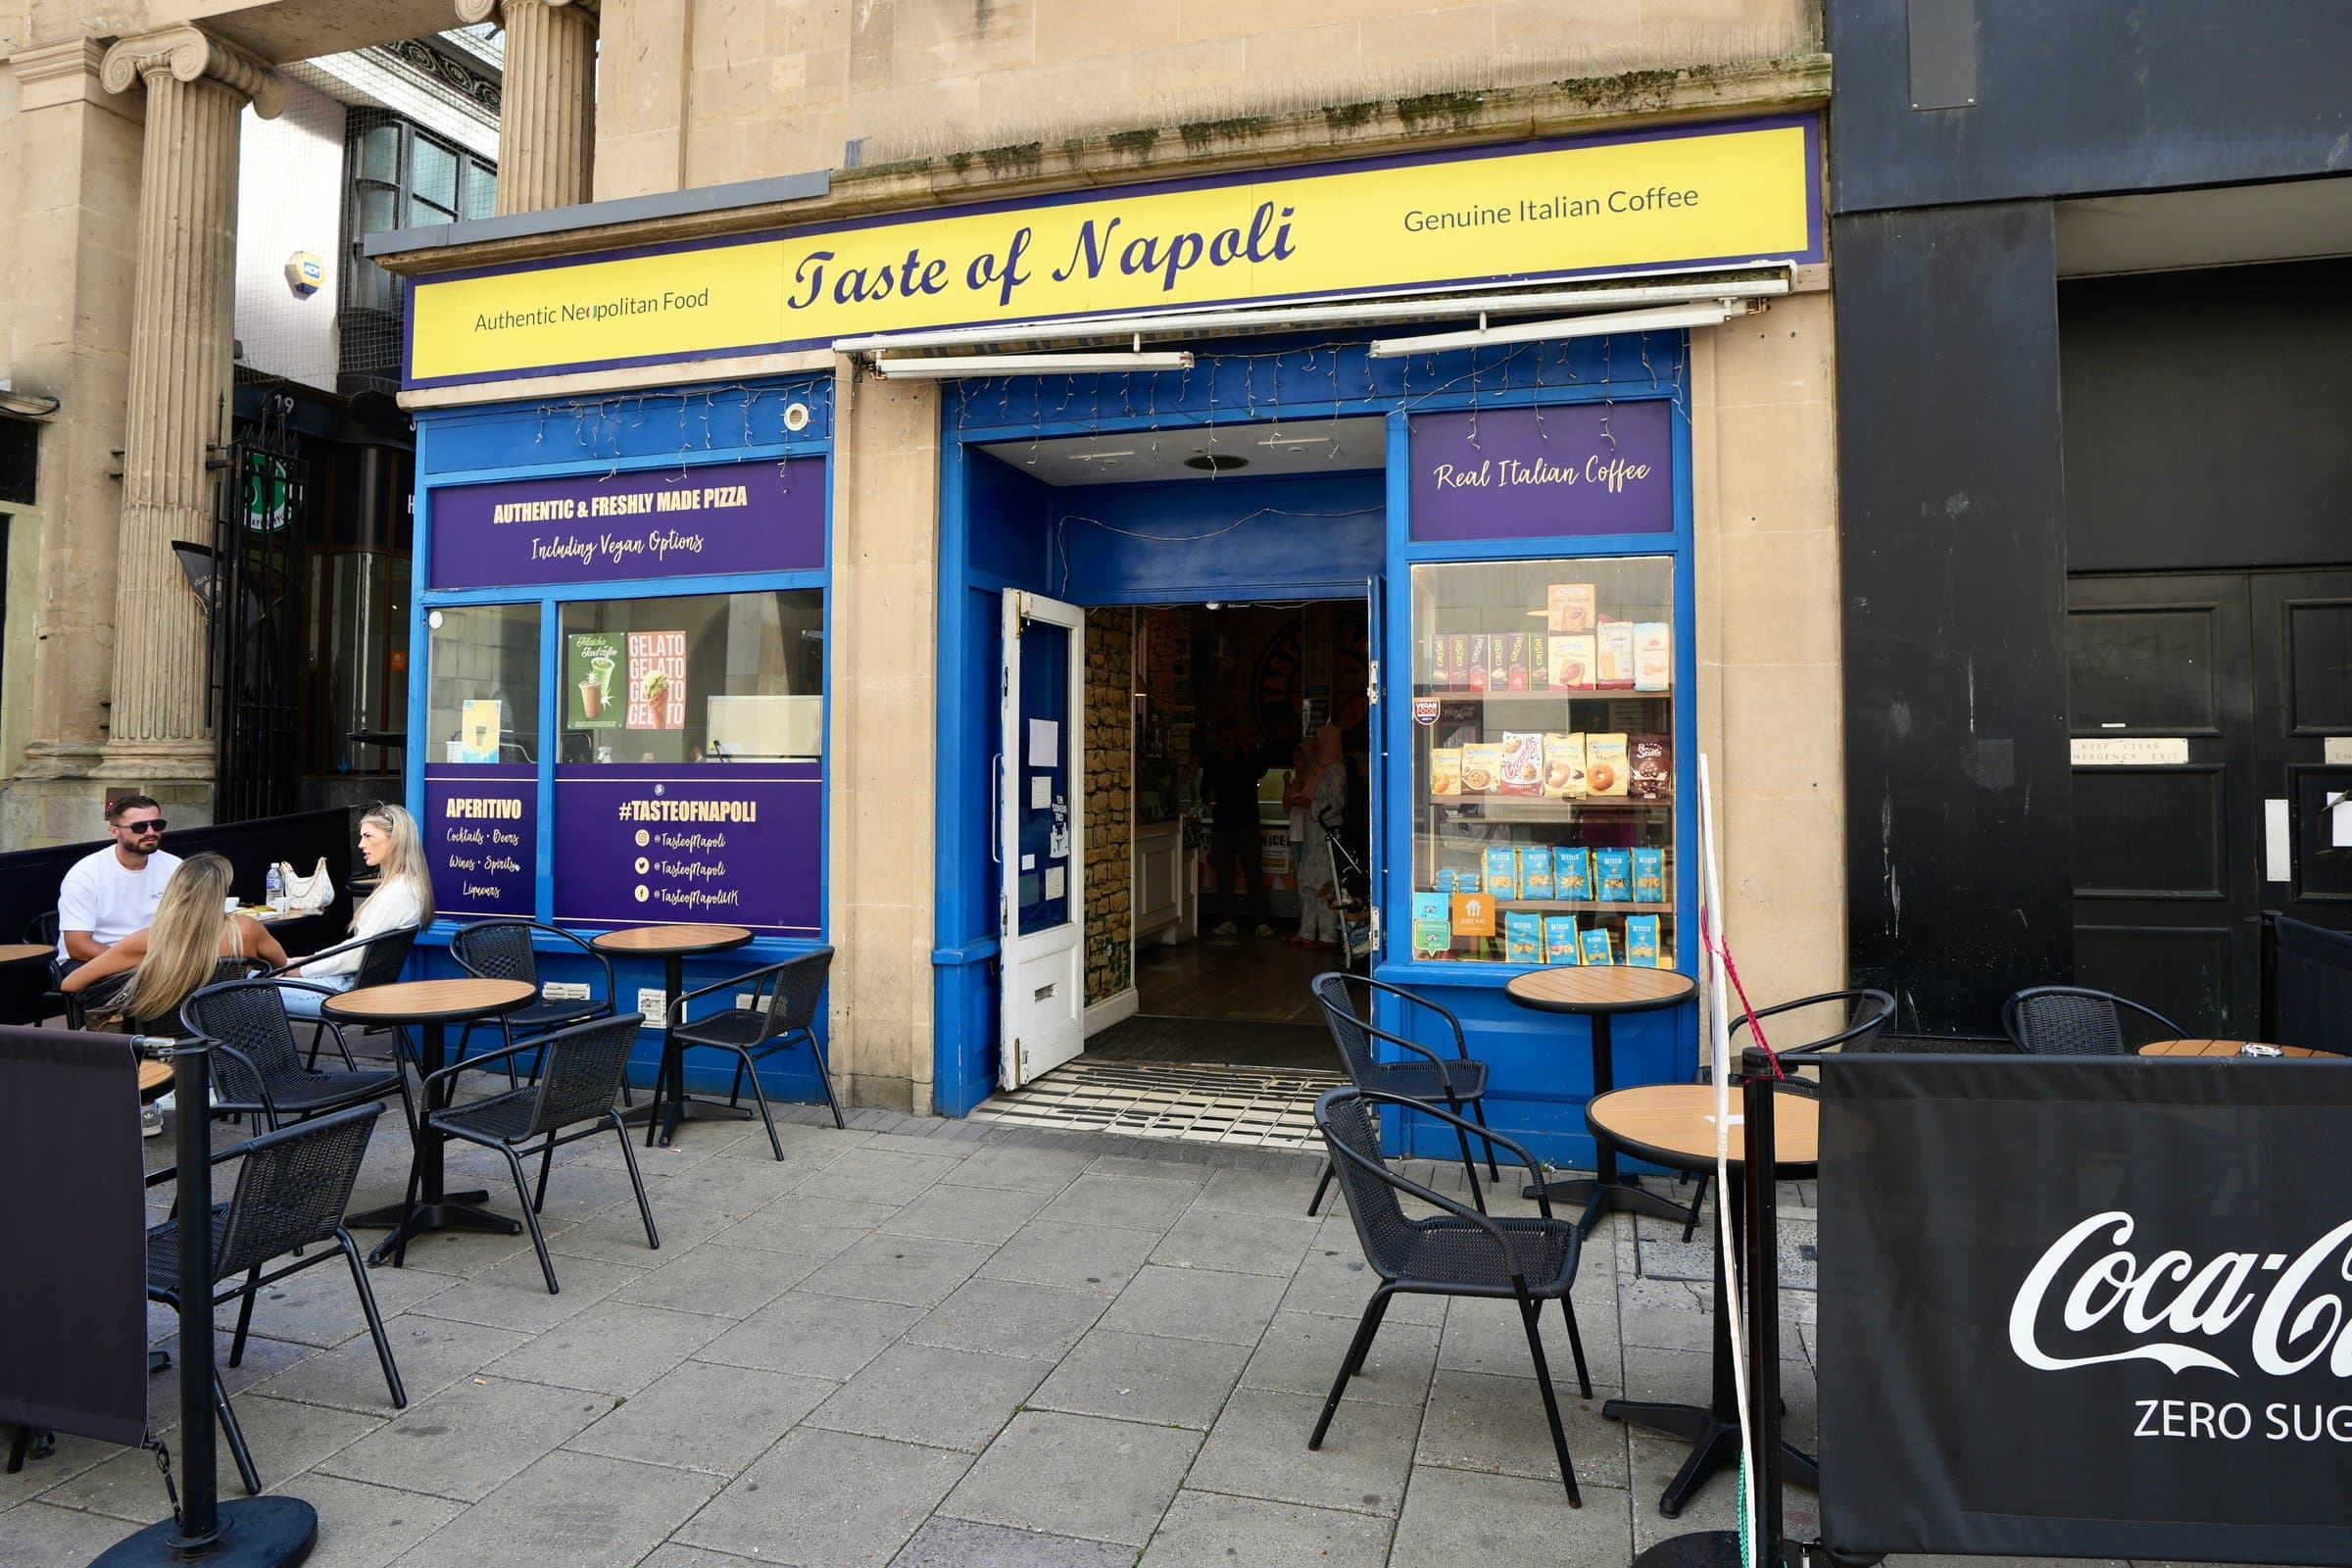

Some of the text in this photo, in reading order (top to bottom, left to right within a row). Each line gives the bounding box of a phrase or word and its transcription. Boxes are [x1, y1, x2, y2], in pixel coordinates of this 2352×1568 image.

[1404, 186, 1698, 232] Genuine Italian Coffee
[787, 201, 1296, 310] Taste of Napoli
[474, 287, 709, 332] Authentic Neapolitan Food
[274, 394, 294, 415] 19
[1433, 455, 1651, 493] Real Italian Coffee
[494, 485, 748, 524] AUTHENTIC & FRESHLY MADE PIZZA
[531, 528, 705, 564] Including Vegan Options
[629, 634, 684, 658] GELATO
[628, 703, 684, 725] GELTO
[446, 798, 522, 819] APERITIVO
[618, 800, 757, 822] #TASTEOFNAPOLI
[446, 826, 519, 846] Cocktails Beers
[655, 833, 726, 855] @TasteofNapoli
[449, 855, 516, 875] Wines Spirits
[655, 860, 726, 883] @TasteofNapoli
[463, 880, 501, 900] Liqueurs
[655, 889, 739, 910] @TasteofNapoliUK
[2009, 1210, 2352, 1379] Coca-C
[2133, 1399, 2352, 1443] ZERO SUG
